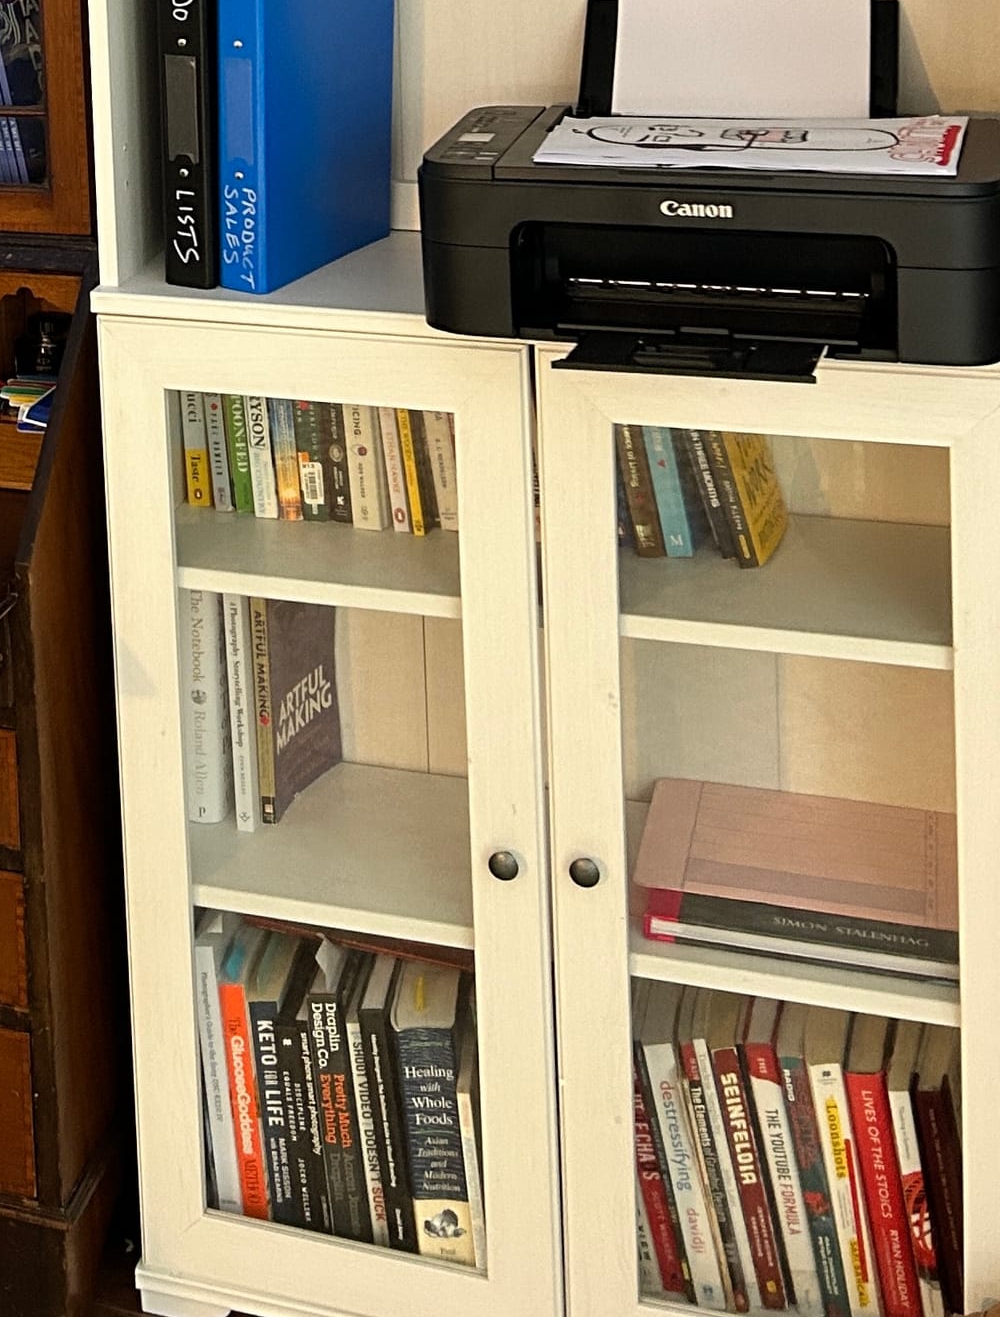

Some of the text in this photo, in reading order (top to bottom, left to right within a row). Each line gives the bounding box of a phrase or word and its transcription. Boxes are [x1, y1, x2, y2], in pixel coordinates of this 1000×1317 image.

[176, 189, 200, 265] LISTS
[223, 185, 240, 265] SALES
[660, 200, 733, 220] Canon
[240, 186, 257, 290] PRODUCT
[352, 405, 362, 437] ICING
[190, 454, 202, 482] Taste
[702, 471, 720, 508] MONTHS
[190, 591, 204, 683] The Notebook
[229, 607, 245, 747] Photography Storytelling Workshop
[253, 611, 269, 719] ARTFUL MAKING
[276, 683, 332, 754] MAKING
[279, 664, 327, 727] ARTFUL
[194, 711, 209, 795] Roland Allen
[772, 916, 828, 933] SIMON
[311, 1003, 328, 1069] Design Co.
[324, 1003, 341, 1052] Draplin
[256, 1020, 284, 1127] KETO FOR LIFE
[352, 1041, 368, 1079] SHOOT
[404, 1065, 454, 1083] Healing
[283, 1071, 298, 1142] EQUALS FREEDOM
[294, 1083, 306, 1132] DISCIPLINE
[300, 1032, 322, 1155] smart phone smart photography
[320, 1074, 338, 1144] Everything
[358, 1081, 372, 1119] VIDEO
[413, 1096, 453, 1111] Whole
[419, 1081, 442, 1094] with
[690, 1087, 705, 1108] The
[783, 1069, 795, 1101] RADIO
[861, 1090, 877, 1122] LIVES
[333, 1074, 353, 1148] Pretty Much
[415, 1112, 454, 1125] Foods
[695, 1109, 711, 1147] Elements
[720, 1072, 757, 1185] SEINFELDIA
[363, 1128, 382, 1183] DOESN'T
[424, 1136, 449, 1145] Asian
[826, 1104, 846, 1179] Loonshots
[867, 1126, 881, 1146] OF
[871, 1148, 885, 1172] THE
[271, 1151, 280, 1171] BRAD
[278, 1137, 292, 1198] MARK SISSON
[297, 1158, 307, 1184] JOCKO
[659, 1080, 693, 1191] destressifying
[686, 1207, 706, 1254] davidji
[765, 1109, 801, 1236] THE YOUTUBE FORMULA
[371, 1186, 386, 1221] SUCK
[875, 1174, 893, 1219] STOICS
[889, 1229, 909, 1309] RYAN HOLIDAY
